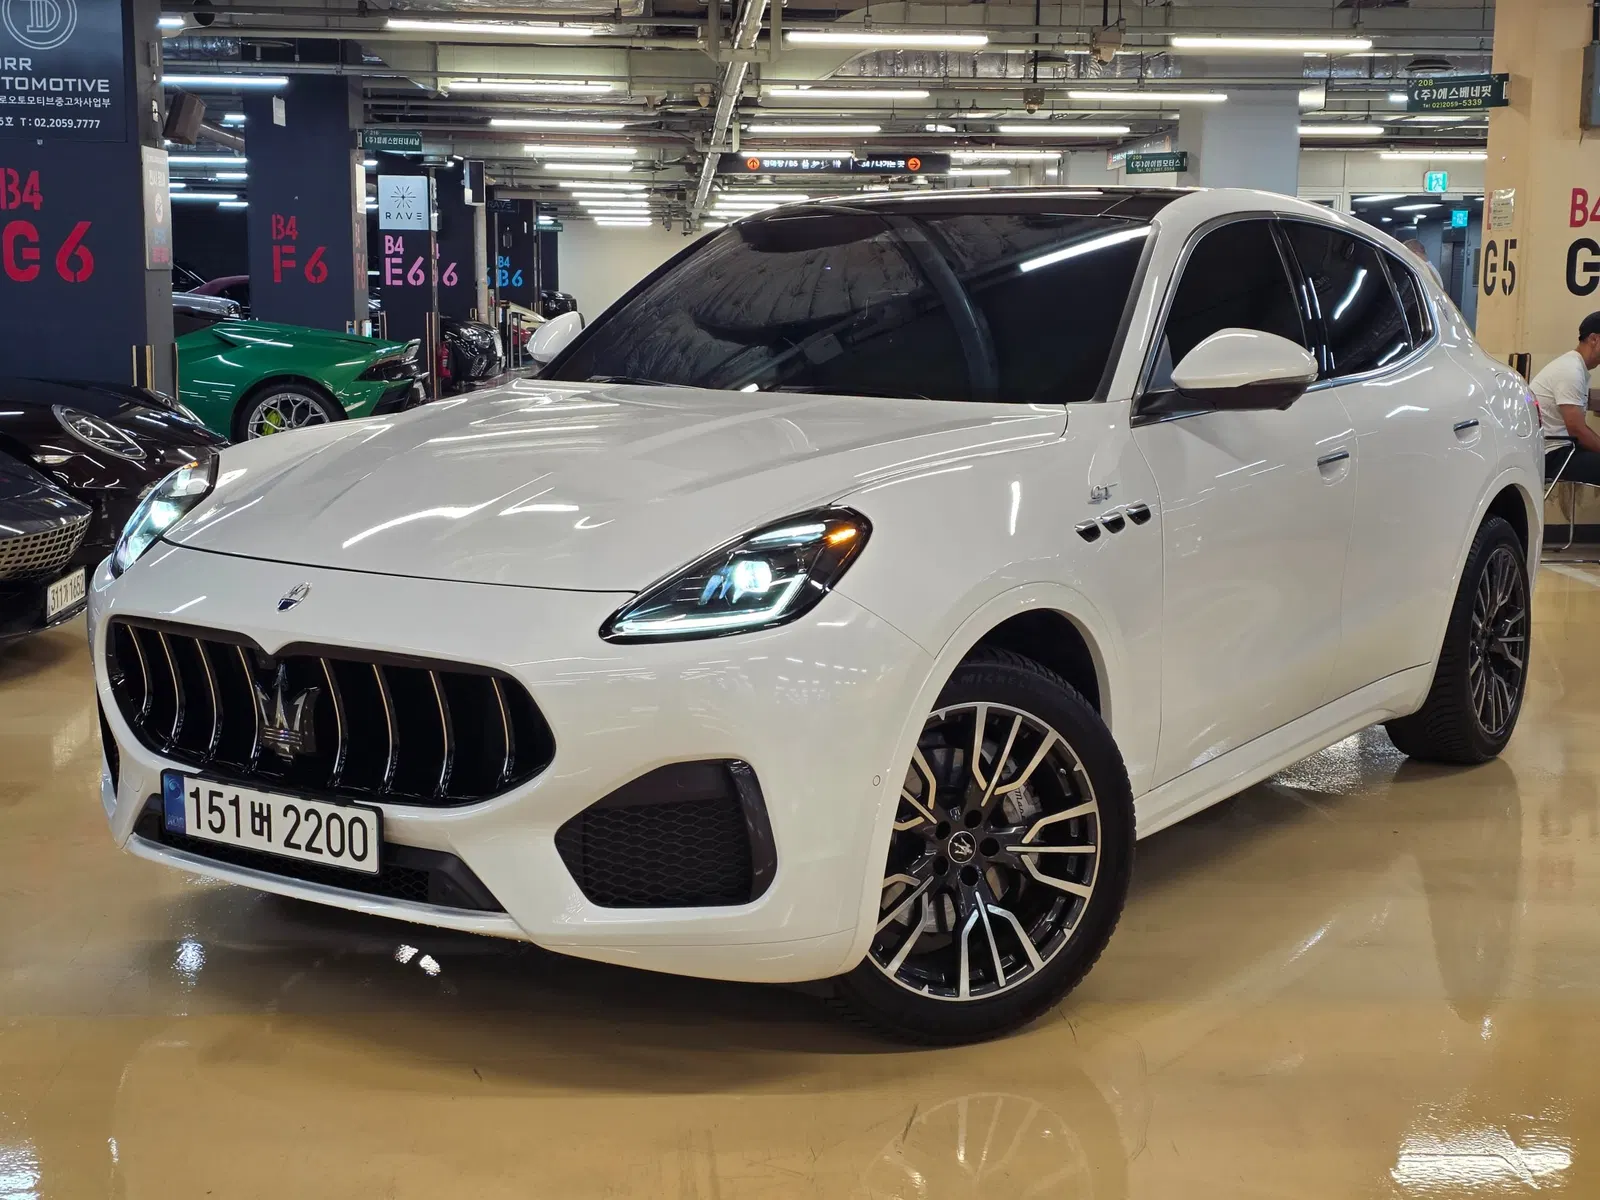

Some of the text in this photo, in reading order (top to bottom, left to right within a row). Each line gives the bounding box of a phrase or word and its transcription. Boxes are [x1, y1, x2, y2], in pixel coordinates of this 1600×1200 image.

[0, 57, 32, 70] RR
[1414, 85, 1492, 100] (주)에스베네핏
[34, 118, 101, 129] 02.2059.7777
[0, 167, 43, 210] B4
[385, 212, 422, 220] RAVE
[271, 214, 298, 240] B4
[384, 235, 404, 255] B4
[498, 255, 510, 268] B4
[1483, 239, 1517, 296] G5
